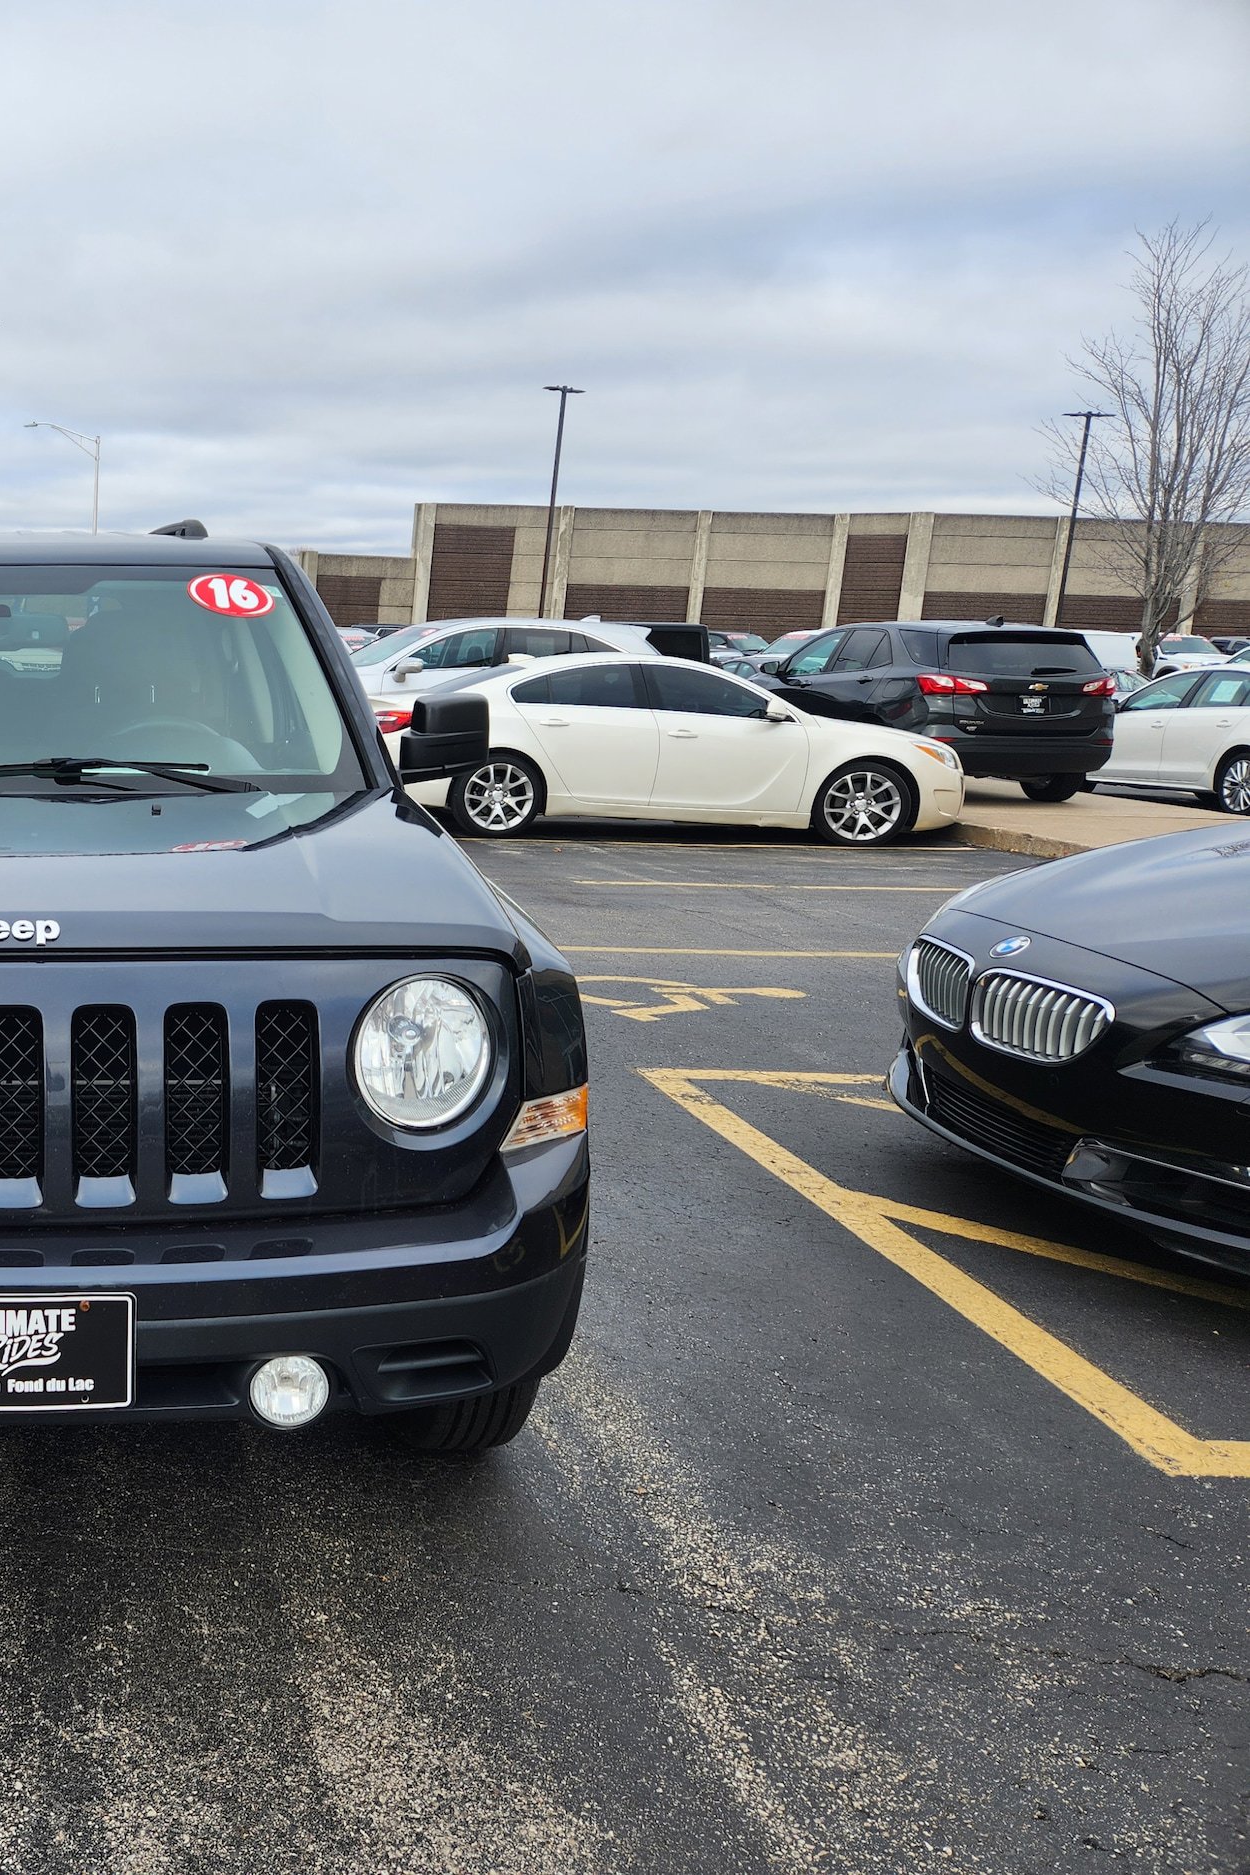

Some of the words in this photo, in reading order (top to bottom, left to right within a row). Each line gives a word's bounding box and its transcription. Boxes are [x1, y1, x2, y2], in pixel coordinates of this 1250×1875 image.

[208, 578, 259, 609] 16
[7, 1377, 44, 1393] Fond
[46, 1378, 66, 1393] du
[68, 1377, 95, 1392] Lac
